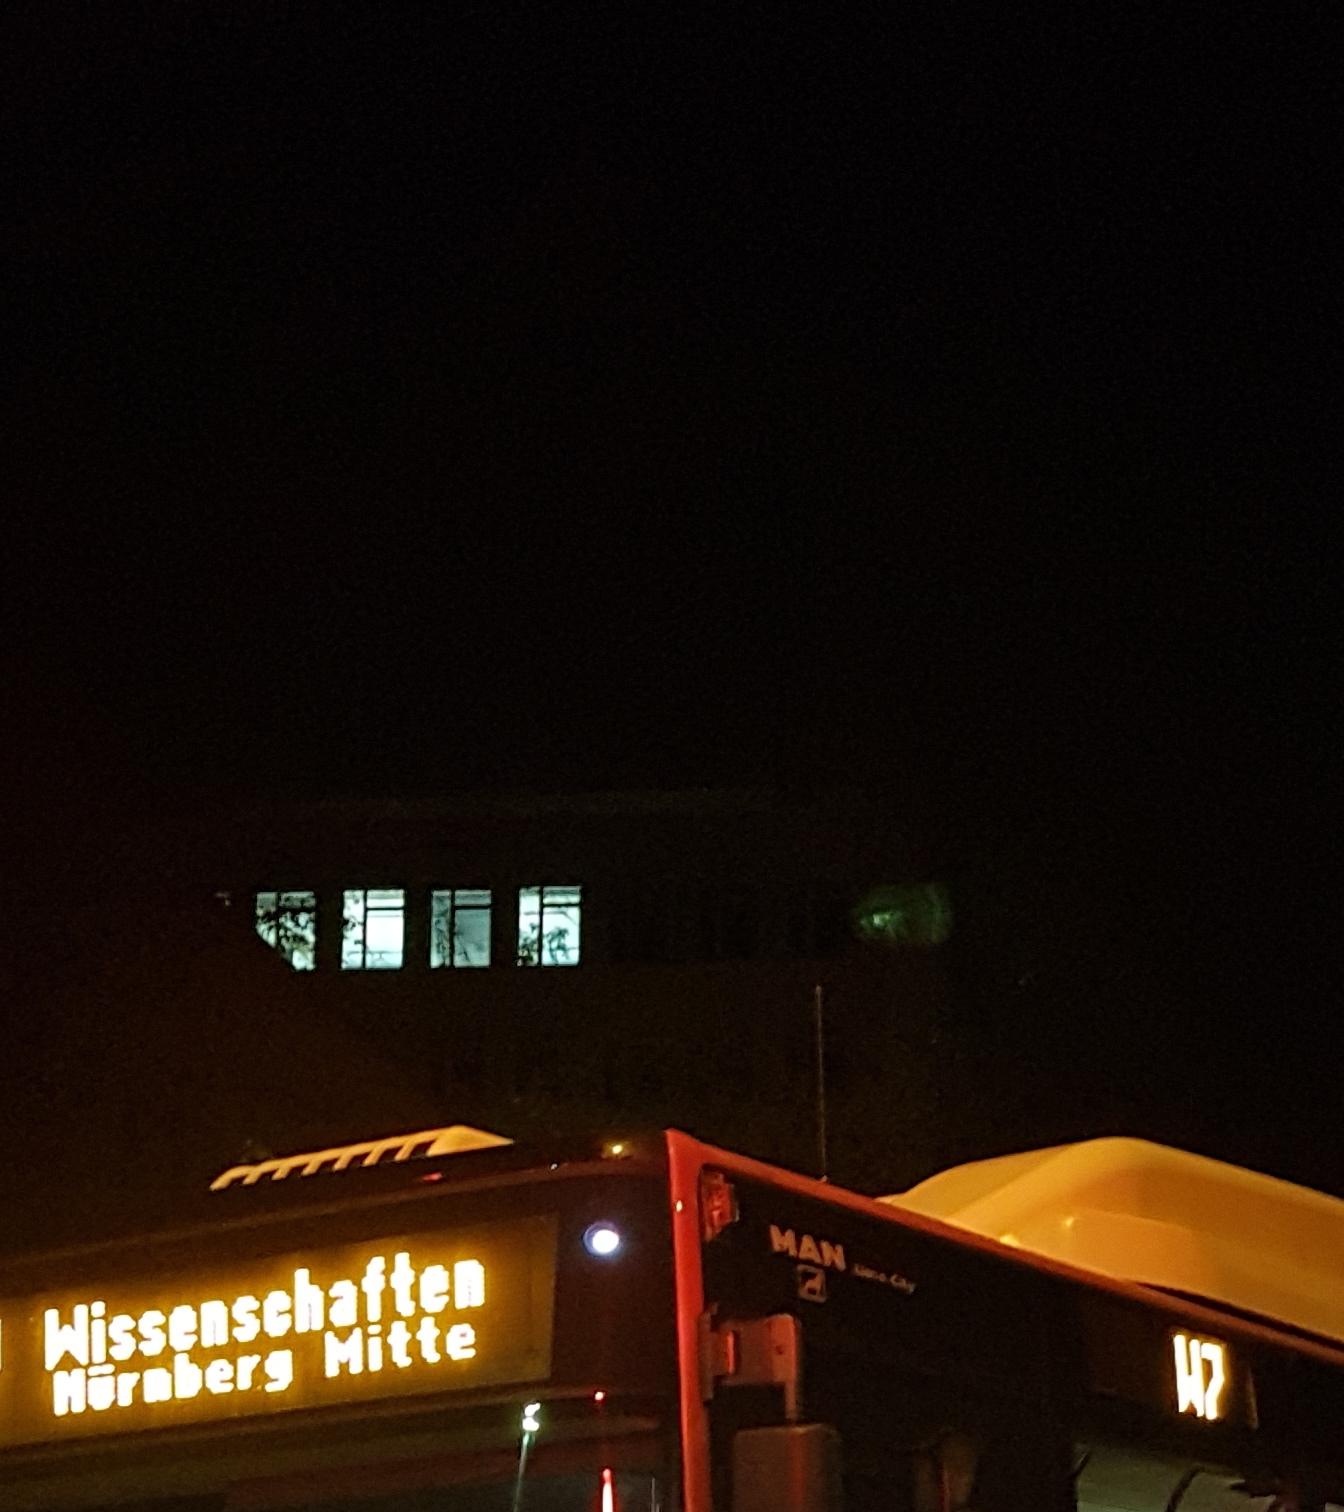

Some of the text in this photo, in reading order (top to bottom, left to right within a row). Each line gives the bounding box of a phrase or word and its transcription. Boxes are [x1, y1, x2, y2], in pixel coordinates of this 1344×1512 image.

[769, 1223, 847, 1272] MAN
[44, 1251, 486, 1371] Wissenschaften
[53, 1317, 477, 1416] Nürnberg Mitte
[1172, 1333, 1225, 1421] W7
